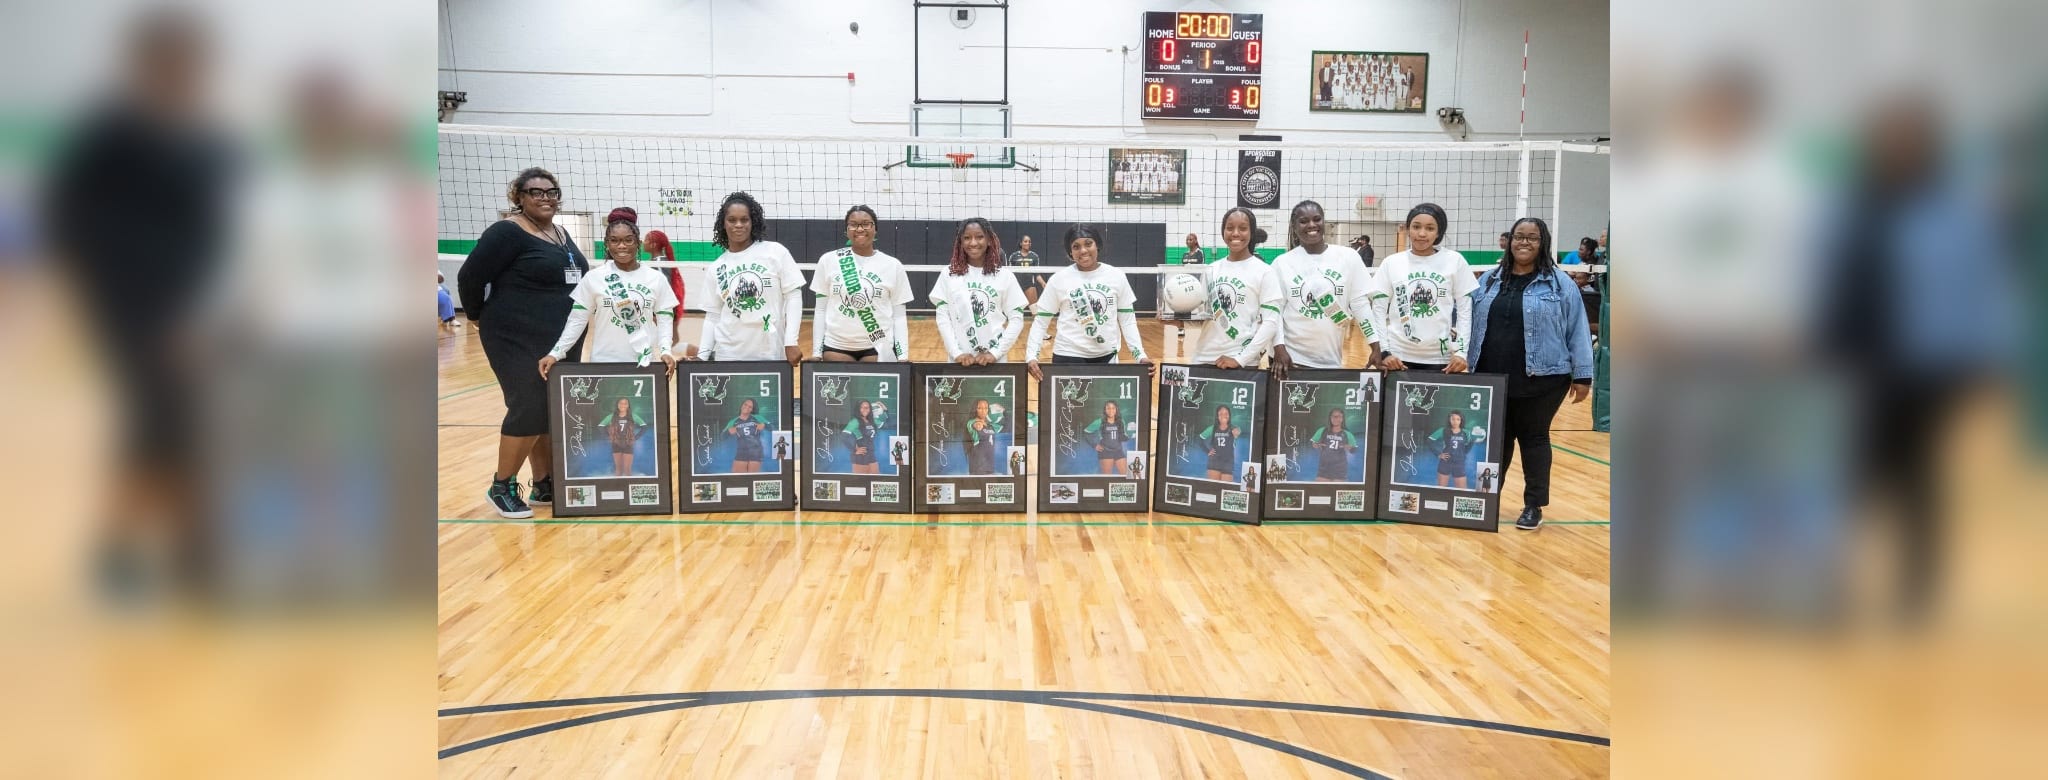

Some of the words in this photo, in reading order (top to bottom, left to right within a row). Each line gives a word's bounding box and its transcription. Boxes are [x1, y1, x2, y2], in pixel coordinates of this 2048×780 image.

[1149, 29, 1174, 39] HOME
[1178, 14, 1231, 37] 20:00
[1233, 31, 1260, 40] GUEST
[1163, 40, 1174, 61] 0
[1248, 41, 1259, 63] 0
[1205, 49, 1209, 70] 1
[1149, 84, 1160, 106] 0
[1166, 88, 1174, 102] 3
[1232, 89, 1240, 104] 3
[1247, 86, 1259, 108] 0
[750, 262, 768, 274] SET
[839, 255, 862, 296] SENIOR
[1325, 268, 1342, 281] SET
[866, 271, 882, 284] SET
[1230, 277, 1246, 290] SET
[1430, 272, 1446, 284] SET
[635, 283, 652, 296] SET
[985, 284, 999, 298] SET
[1096, 283, 1112, 294] SET
[857, 306, 880, 333] 2026
[633, 379, 644, 397] 7
[760, 380, 770, 397] 5
[879, 381, 889, 399] 2
[993, 380, 1006, 397] 4
[1119, 382, 1132, 399] 11
[1231, 387, 1248, 406] 12
[1470, 392, 1482, 410] 3
